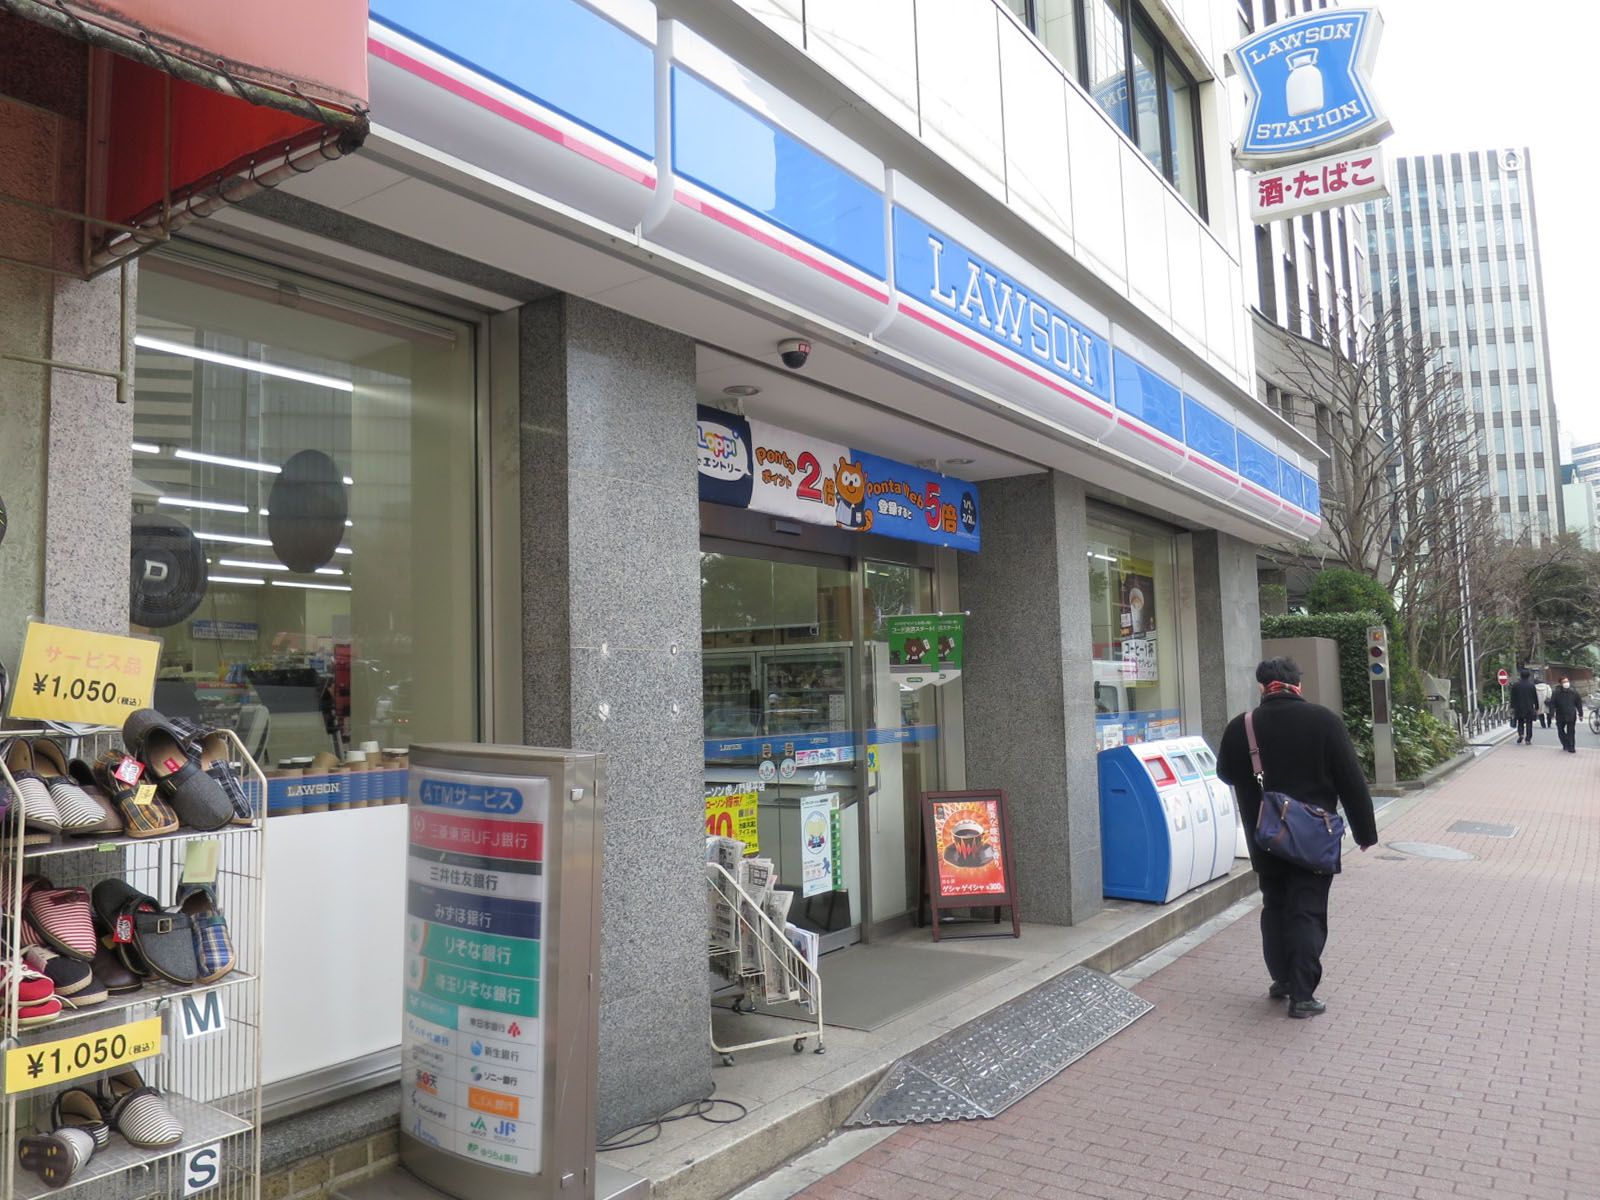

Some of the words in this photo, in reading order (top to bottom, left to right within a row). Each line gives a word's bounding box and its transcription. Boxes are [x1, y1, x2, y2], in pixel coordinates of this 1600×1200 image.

[1250, 23, 1353, 64] LAWSON
[1256, 100, 1361, 139] STATION
[1258, 157, 1375, 207] 酒・たばこ
[928, 236, 1095, 386] LAWSON
[762, 469, 792, 489] ポイント
[46, 645, 144, 678] サービス品
[287, 783, 340, 797] LAWSON
[814, 770, 827, 786] 24
[423, 783, 515, 810] ATMサービス
[429, 866, 499, 891] 三井住友銀行
[434, 903, 492, 929] みずほ銀行
[445, 936, 512, 965] りそな銀行
[182, 991, 220, 1036] M
[484, 1046, 519, 1063] 新生銀行
[188, 1149, 218, 1188] S
